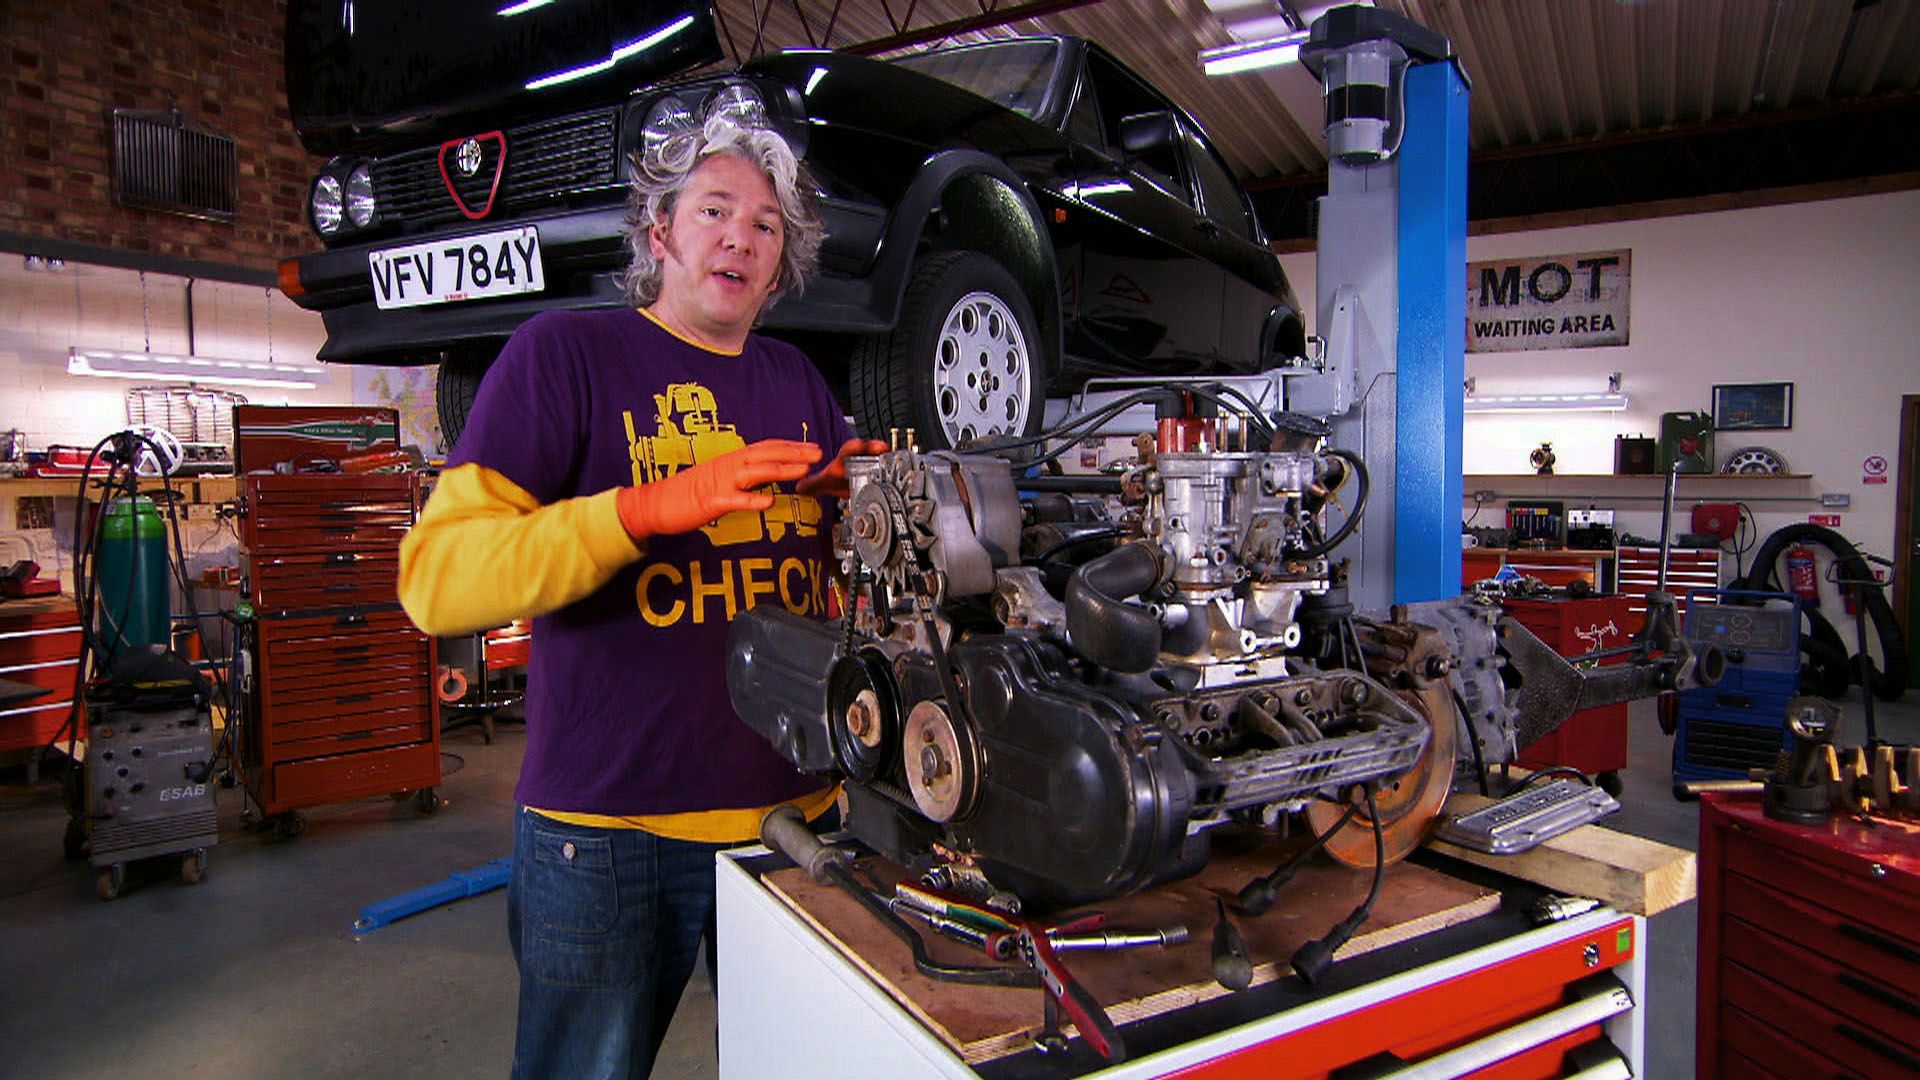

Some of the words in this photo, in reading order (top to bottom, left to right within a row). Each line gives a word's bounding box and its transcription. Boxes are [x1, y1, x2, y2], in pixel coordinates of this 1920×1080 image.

[372, 252, 433, 302] VFV
[444, 236, 536, 291] 784Y
[1479, 256, 1619, 308] MOT
[1474, 317, 1555, 338] WAITING
[1559, 314, 1616, 334] AREA
[159, 784, 206, 801] ESAB
